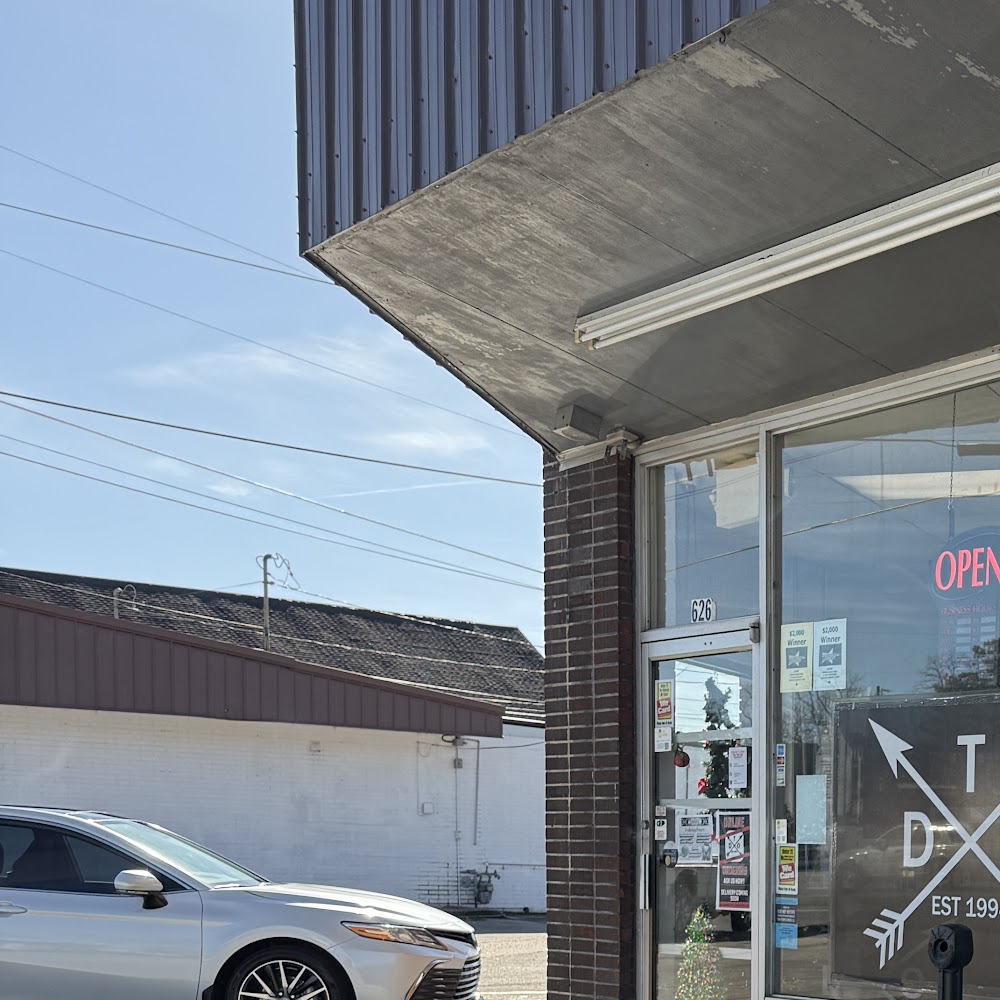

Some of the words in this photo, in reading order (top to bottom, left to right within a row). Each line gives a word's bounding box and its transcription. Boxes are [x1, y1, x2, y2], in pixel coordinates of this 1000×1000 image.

[692, 599, 712, 622] 626
[820, 636, 840, 644] Winner
[822, 626, 838, 634] $2,000
[957, 734, 986, 792] T
[903, 811, 934, 868] D
[932, 896, 962, 916] EST
